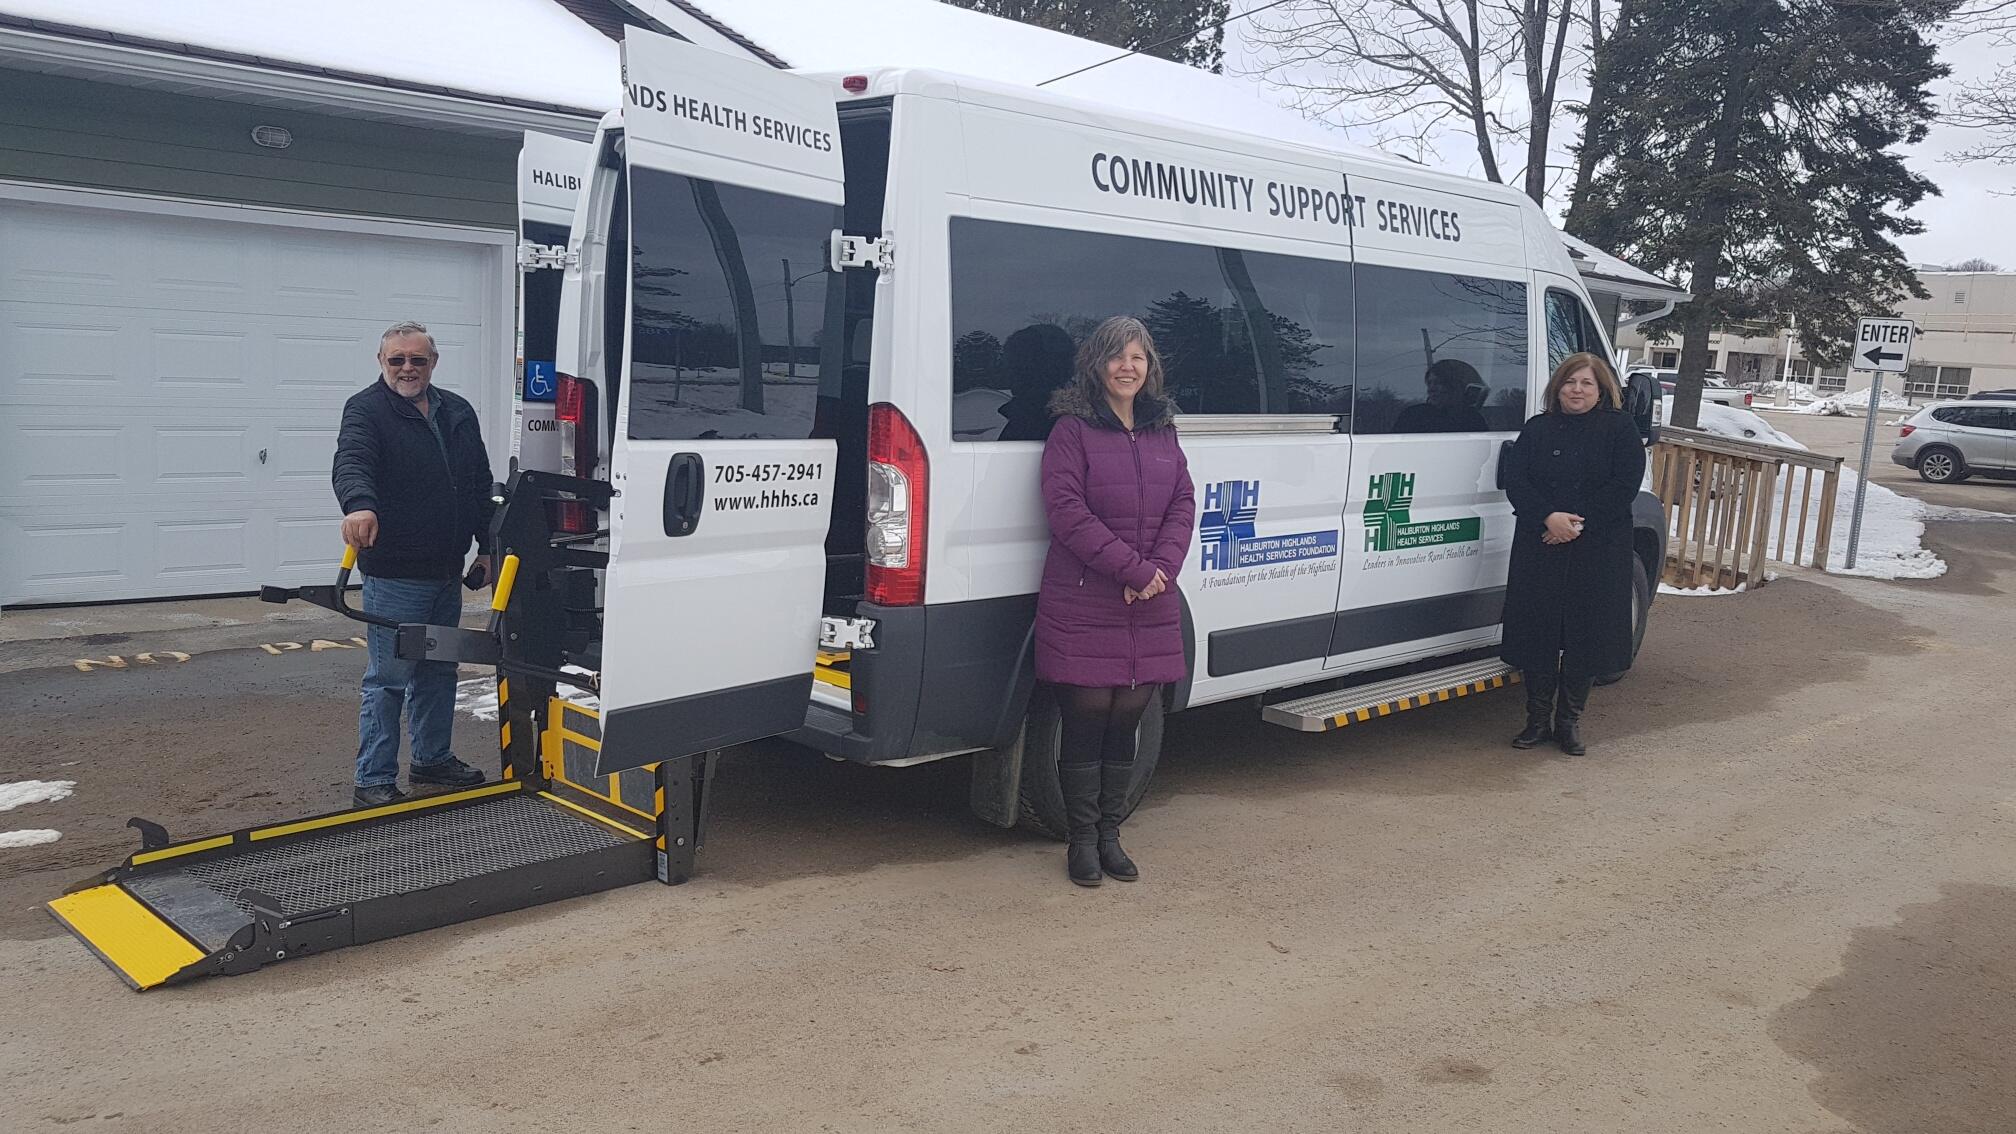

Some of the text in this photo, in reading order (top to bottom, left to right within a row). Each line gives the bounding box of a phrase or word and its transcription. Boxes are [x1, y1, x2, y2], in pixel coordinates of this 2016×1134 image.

[628, 84, 832, 152] NDS HEALTH SERVICES
[1091, 153, 1461, 242] COMMUNITY SUPPORT SERVICES
[1861, 324, 1909, 343] ENTER
[715, 463, 822, 483] 705-457-2941
[714, 489, 819, 511] www.hhhs.ca
[1397, 522, 1460, 536] HALIBURTON HIGHLANDS
[1240, 536, 1317, 553] HALIBURTON HIGHLANDS
[1396, 534, 1444, 547] HEALTH SERVICES
[1240, 544, 1336, 564] HEALTH SERVICES FOUNDATION
[1362, 545, 1479, 570] Leaders in Innovative Rural Health Care
[1200, 560, 1337, 591] A Foundation for the Health of the Highlands
